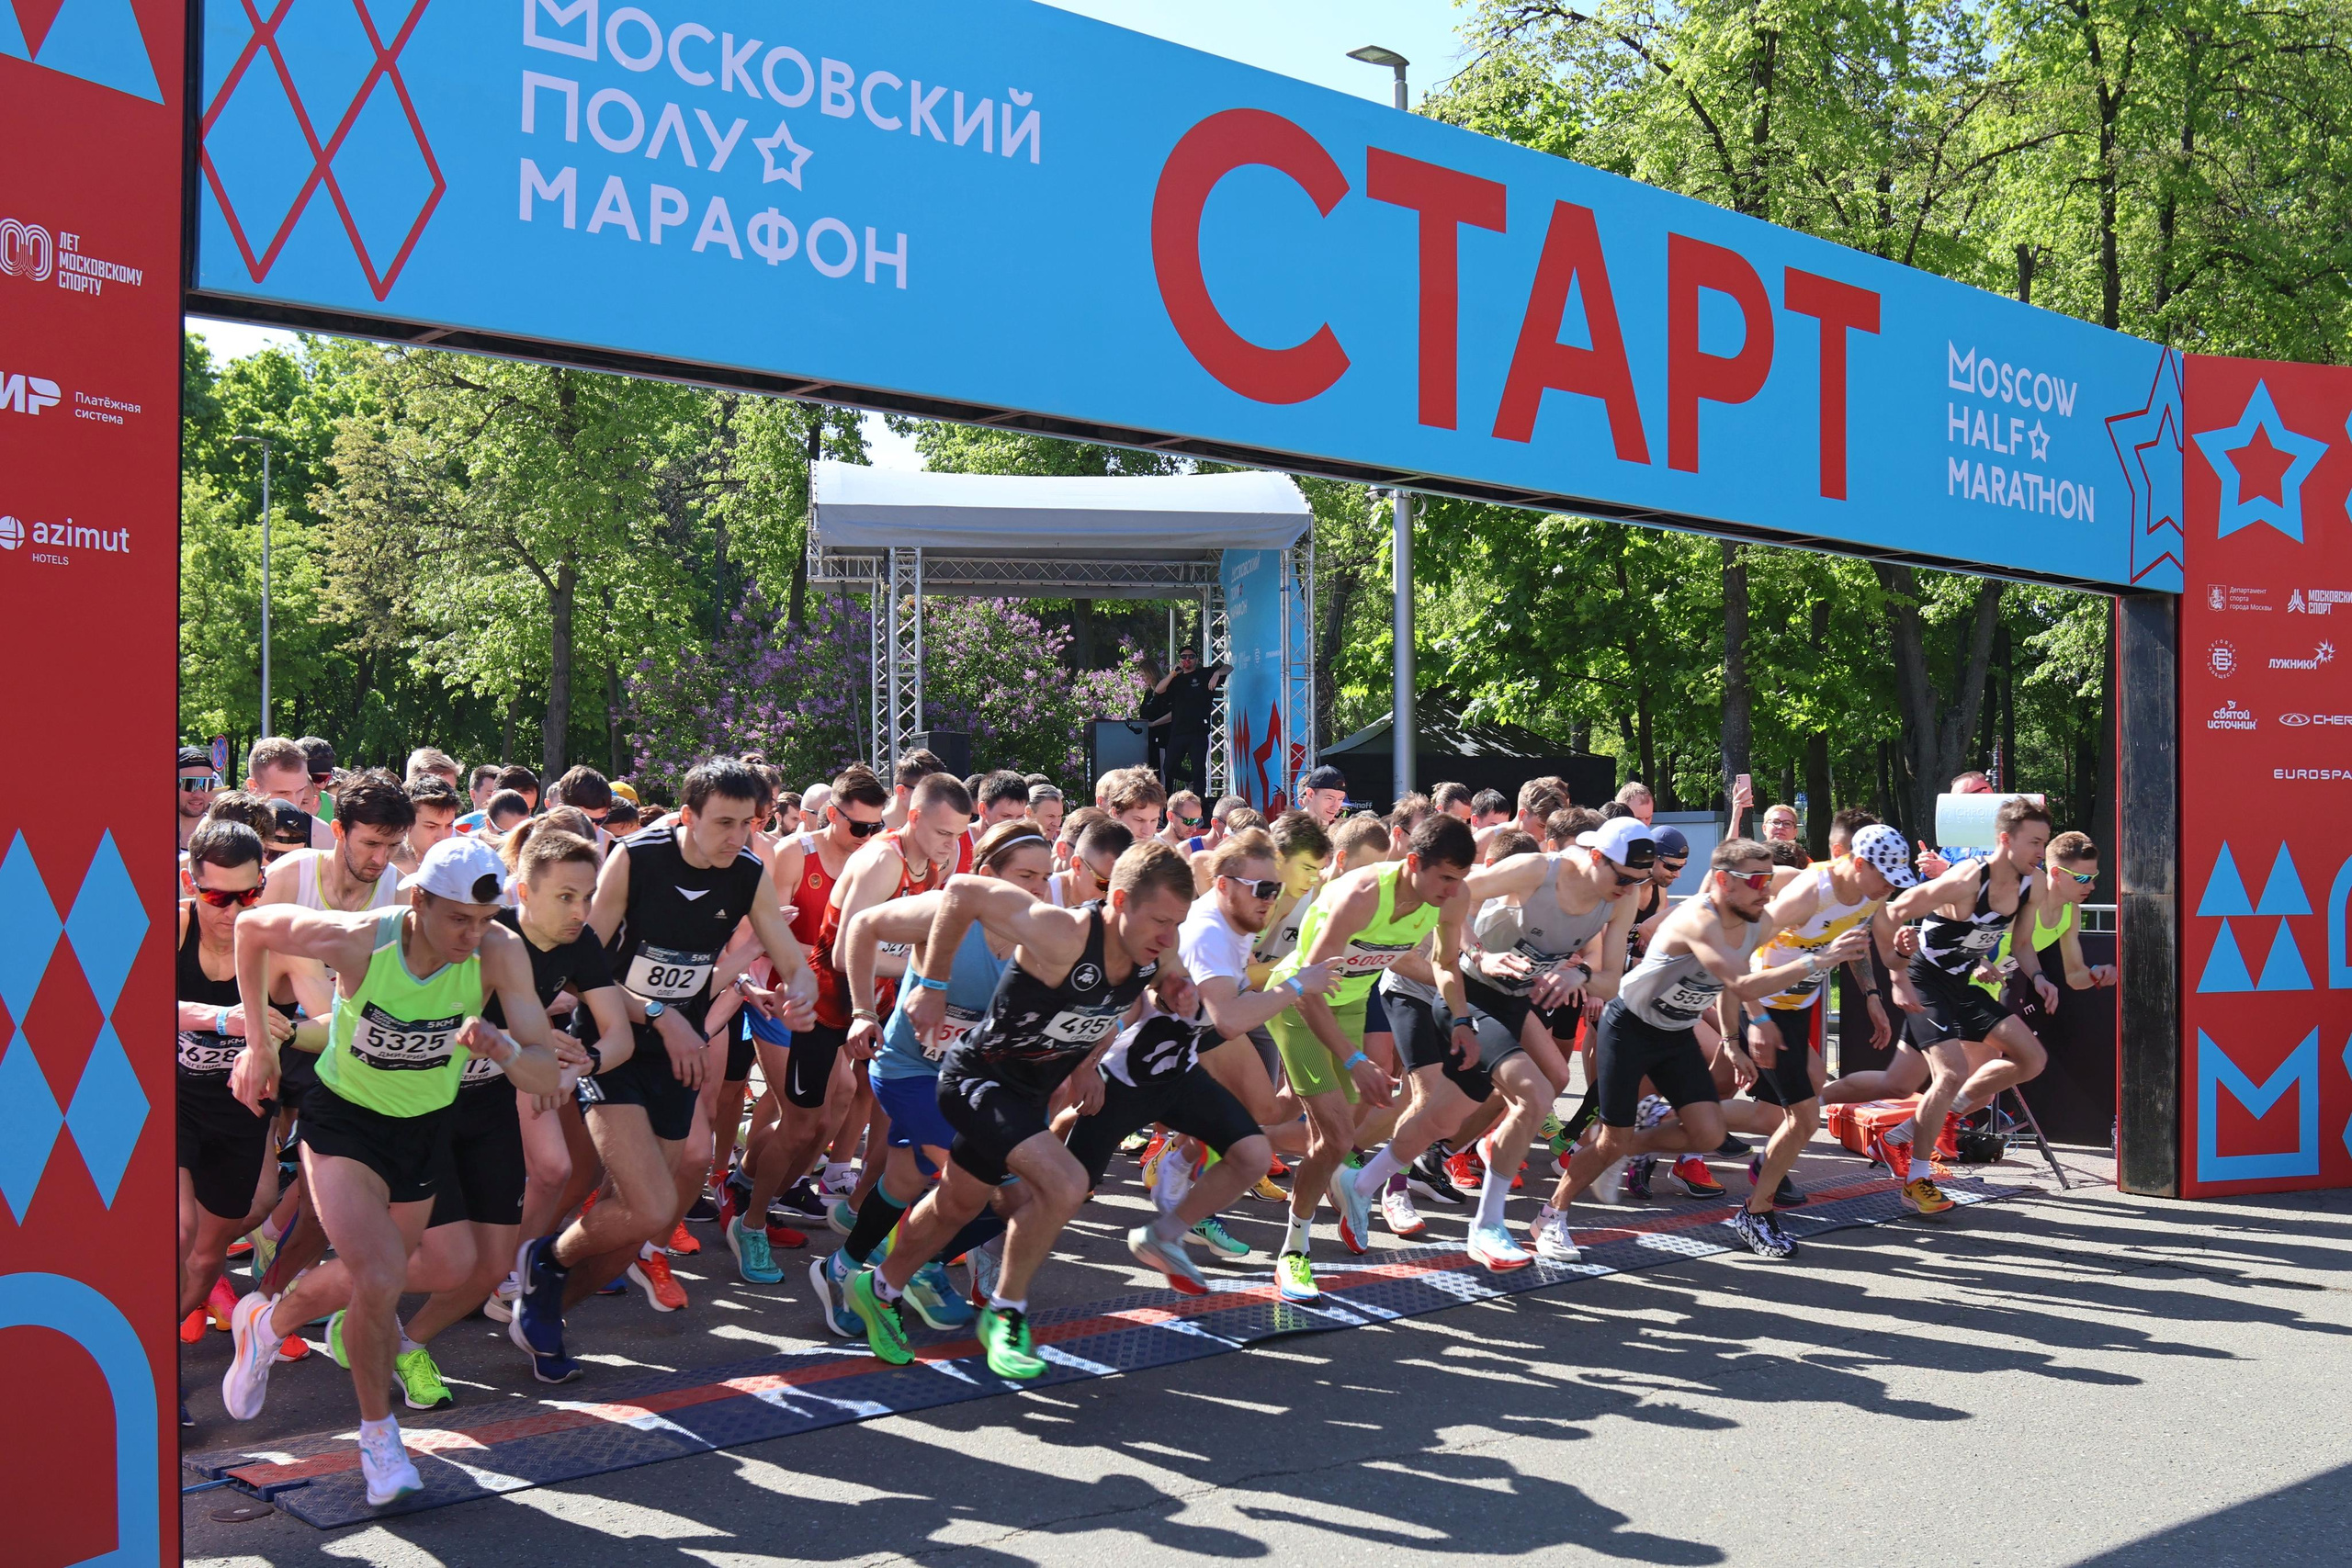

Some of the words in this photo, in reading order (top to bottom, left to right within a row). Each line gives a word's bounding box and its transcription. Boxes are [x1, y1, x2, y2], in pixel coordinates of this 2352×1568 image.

[521, 70, 749, 173] ПОЛУ
[519, 157, 907, 289] МАРАФОН
[60, 231, 80, 252] ЛЕТ
[59, 251, 142, 287] МОСКОВСКОМУ
[59, 271, 102, 296] СПОРТУ
[1151, 107, 1881, 501] СТАРТ
[1949, 339, 2077, 417] MOSCOW
[75, 391, 141, 413] Платёжная
[75, 408, 123, 424] система
[1949, 402, 2024, 456] HALF
[1949, 457, 2094, 523] MARATHON
[33, 517, 130, 553] azimut
[32, 553, 69, 565] HOTELS
[2230, 586, 2267, 595] Департамент
[2308, 602, 2332, 615] СПОРТ
[2268, 658, 2317, 670] ЛУЖНИКИ
[2273, 768, 2352, 780] EUROSPA
[1347, 954, 1396, 966] 6003
[648, 965, 695, 988] 802
[1673, 989, 1716, 1005] 5557
[1059, 1015, 1119, 1034] 4959
[367, 1026, 448, 1054] 5325
[378, 1051, 427, 1059] ДМИТРИЙ
